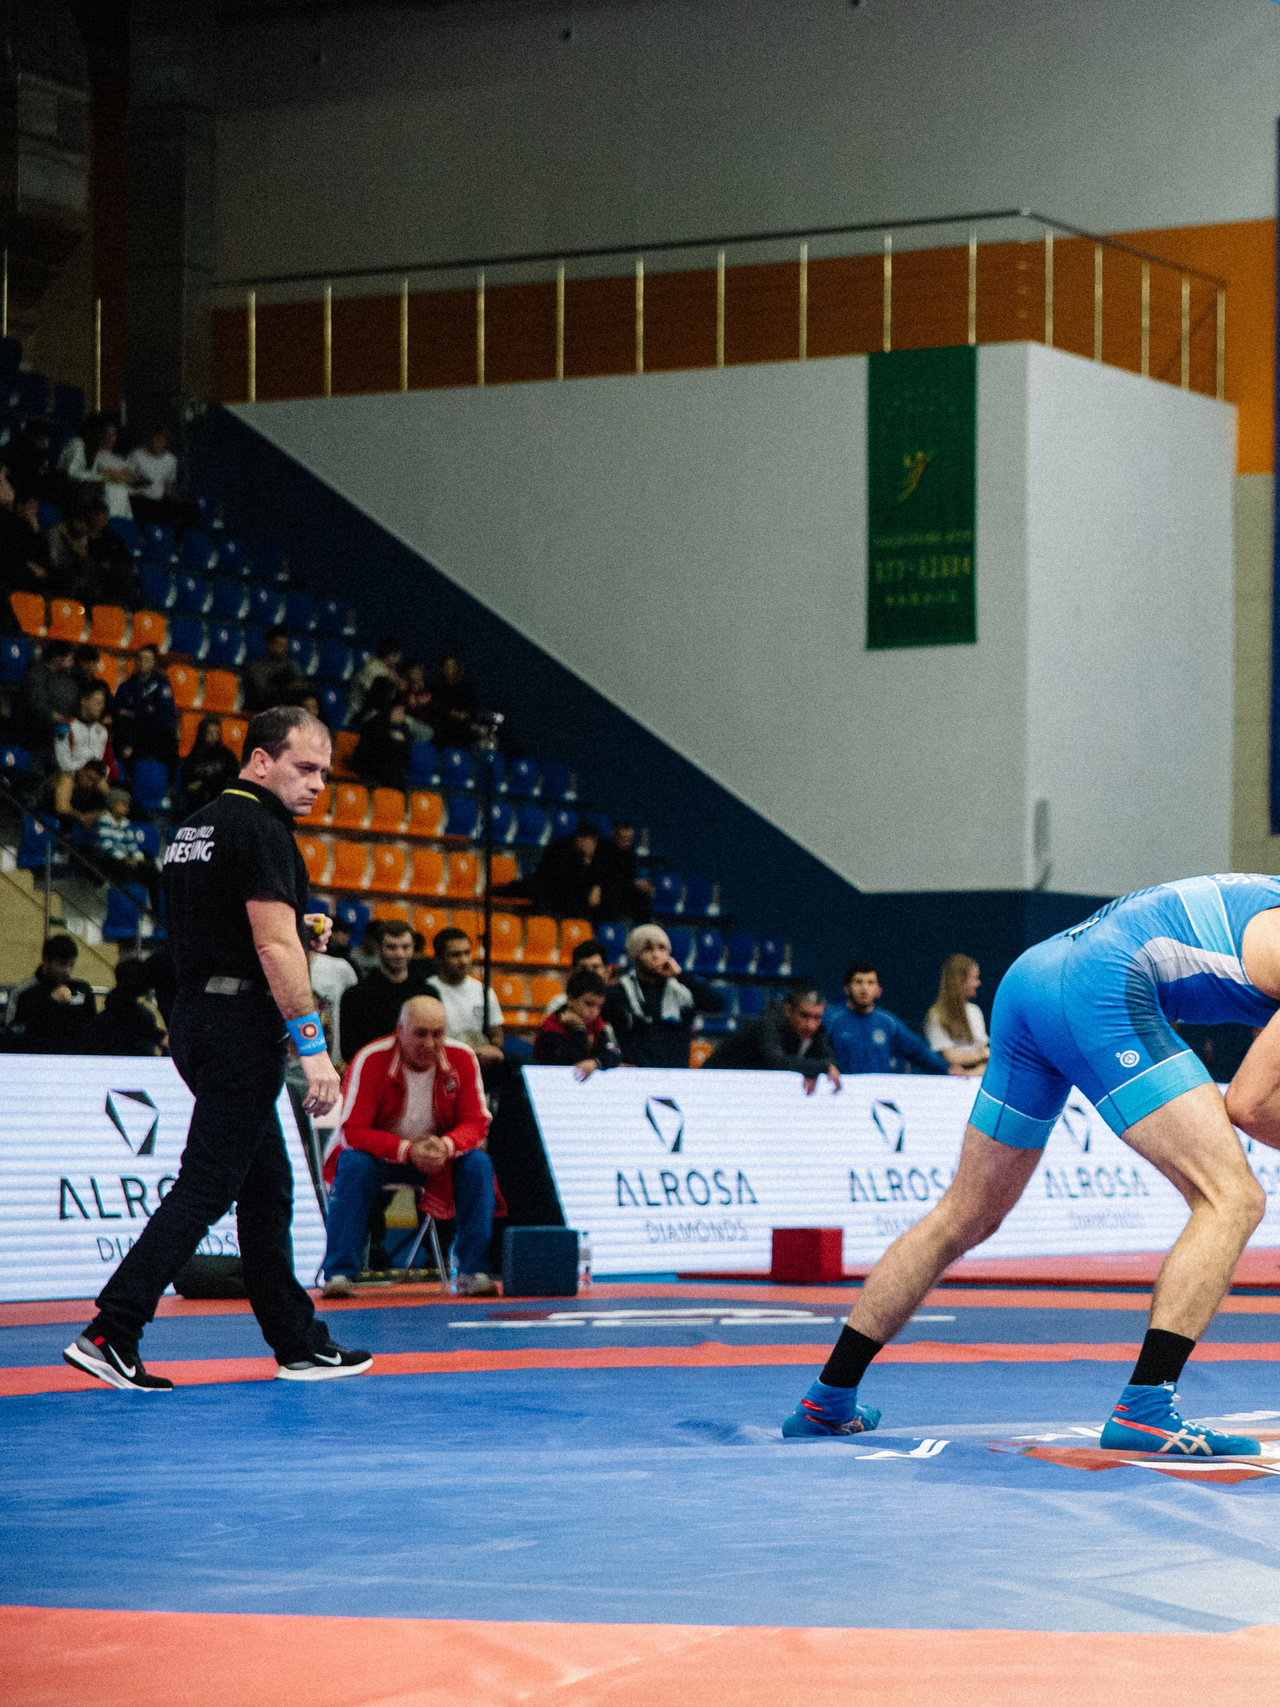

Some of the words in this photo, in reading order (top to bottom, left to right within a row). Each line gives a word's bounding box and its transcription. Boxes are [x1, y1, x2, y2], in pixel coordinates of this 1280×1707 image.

[616, 1168, 759, 1207] ALROSA
[848, 1167, 957, 1202] ALROS
[1043, 1166, 1149, 1199] ALROSA
